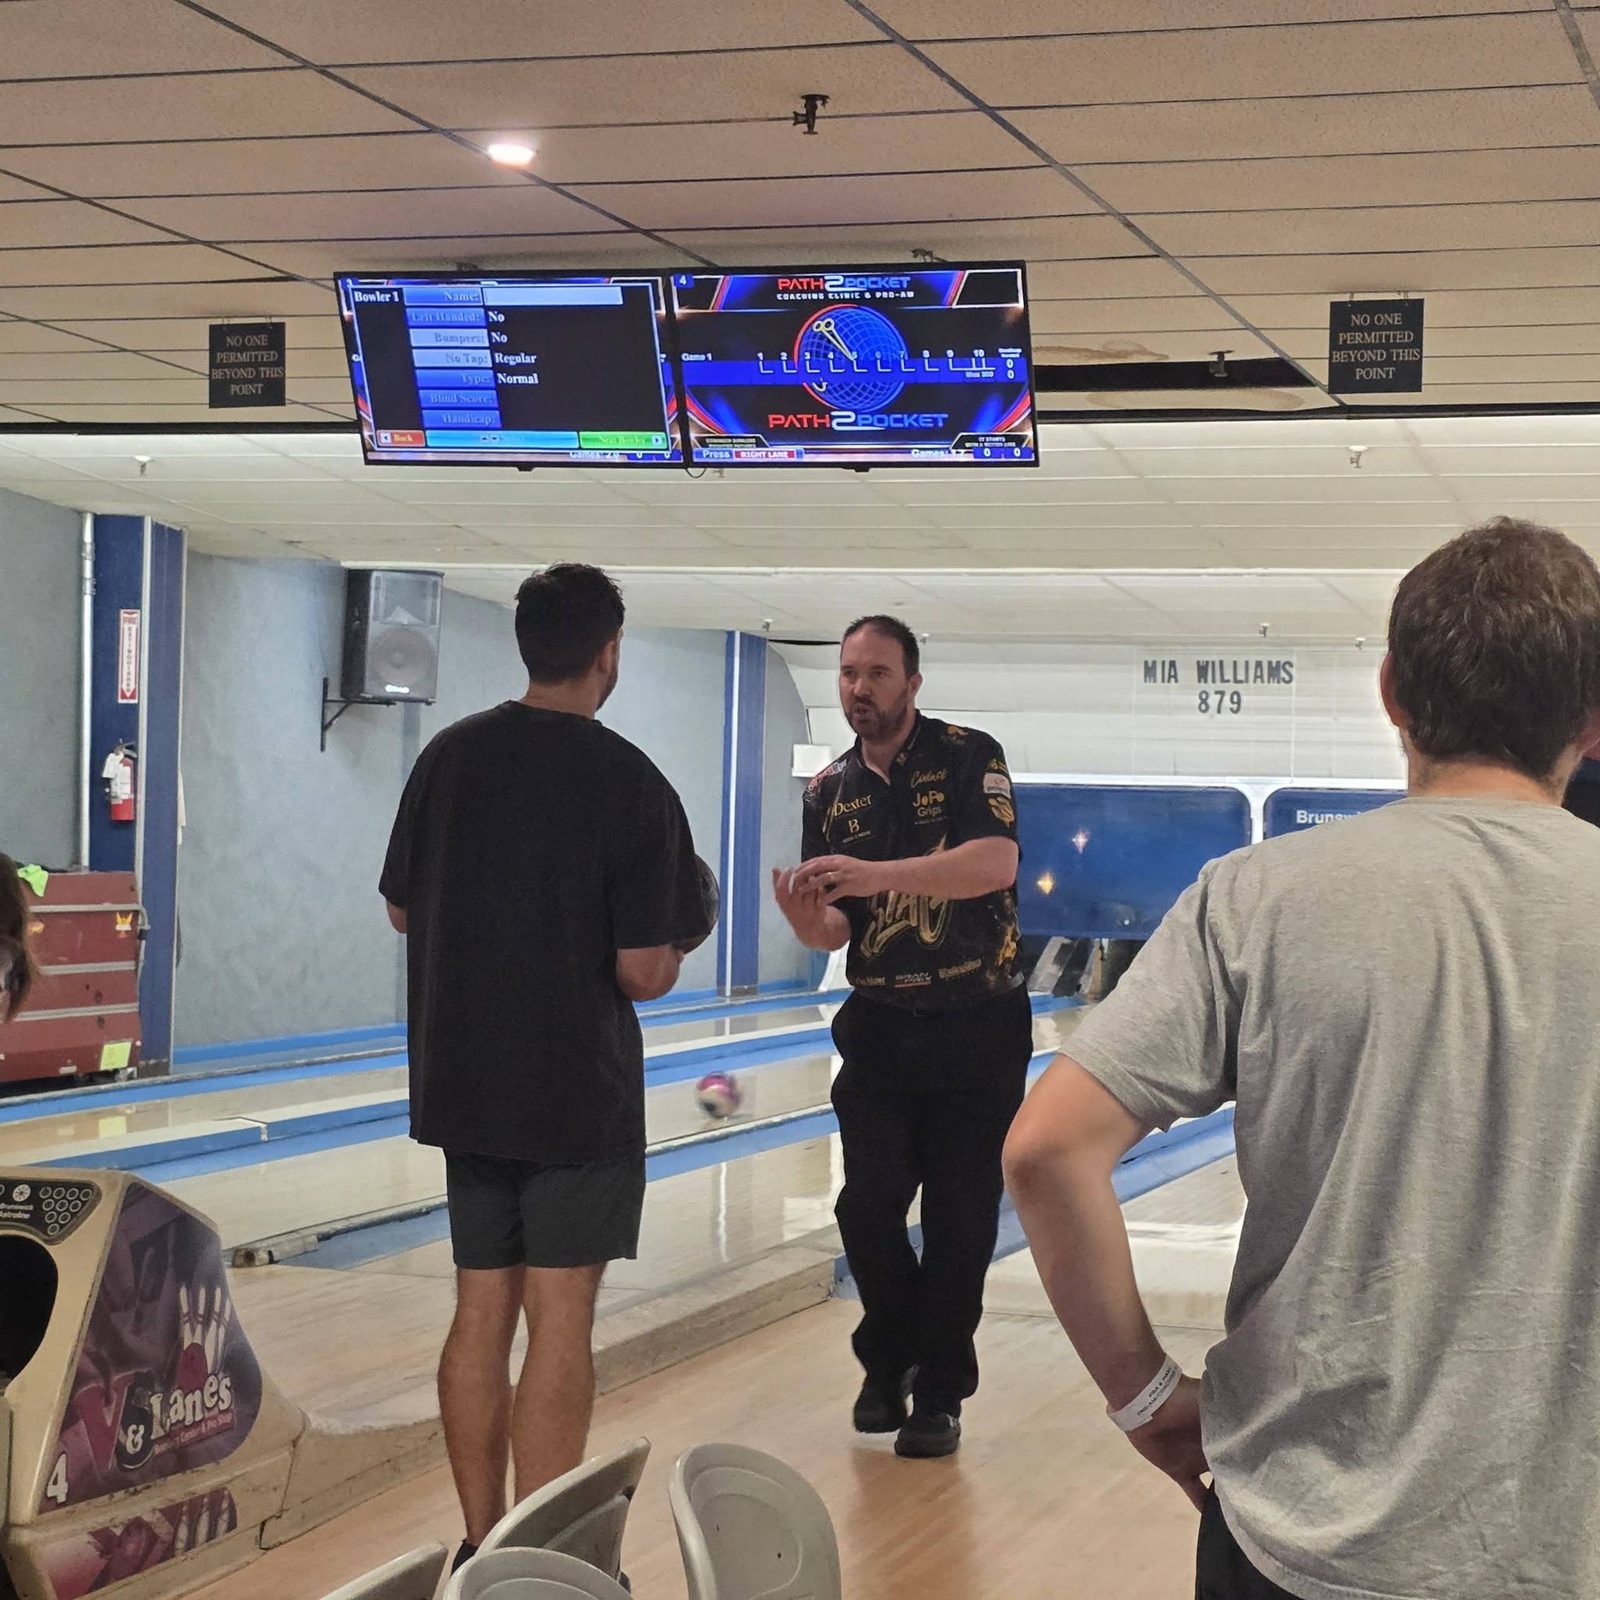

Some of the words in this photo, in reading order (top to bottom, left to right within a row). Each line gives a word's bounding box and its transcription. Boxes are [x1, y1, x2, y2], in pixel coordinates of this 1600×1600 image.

[679, 275, 687, 285] 4
[777, 275, 911, 292] PATH2POCKET
[353, 290, 391, 303] Bowler
[393, 291, 400, 302] 1
[444, 291, 480, 301] Name:
[776, 293, 825, 301] COACHING
[828, 292, 861, 300] CLINIC
[864, 291, 872, 299] &
[488, 311, 505, 322] No
[1350, 313, 1370, 327] NO
[1374, 312, 1403, 326] ONE
[225, 335, 242, 347] NO
[244, 334, 269, 347] ONE
[434, 333, 485, 345] Bumpers:
[490, 332, 508, 343] No
[1338, 330, 1414, 345] PERMITTED
[216, 350, 279, 364] PERMITTED
[494, 352, 537, 366] Regular
[681, 352, 706, 361] Game
[707, 352, 713, 361] 1
[757, 352, 764, 361] 1
[780, 352, 788, 360] 2
[804, 351, 811, 360] 3
[827, 351, 834, 360] 4
[851, 351, 858, 359] 5
[973, 349, 985, 358] 10
[1332, 349, 1387, 363] BEYOND
[1390, 348, 1421, 361] THIS
[1006, 358, 1014, 369] 0
[211, 367, 257, 380] BEYOND
[259, 366, 284, 379] THIS
[497, 373, 539, 384] Normal
[1007, 370, 1015, 379] 0
[1355, 367, 1396, 380] POINT
[230, 383, 264, 396] POINT
[767, 411, 949, 431] PATH2POCKET
[702, 450, 731, 459] Press
[740, 451, 766, 459] RIGHT
[767, 451, 788, 459] LANE
[911, 449, 949, 458] Games:
[983, 447, 991, 457] 0
[1013, 447, 1021, 457] 0
[1143, 660, 1179, 684] MIA
[1196, 660, 1294, 685] WILLIAMS
[1198, 690, 1242, 714] 879
[834, 794, 872, 817] Dexter
[46, 1452, 69, 1504] 4
